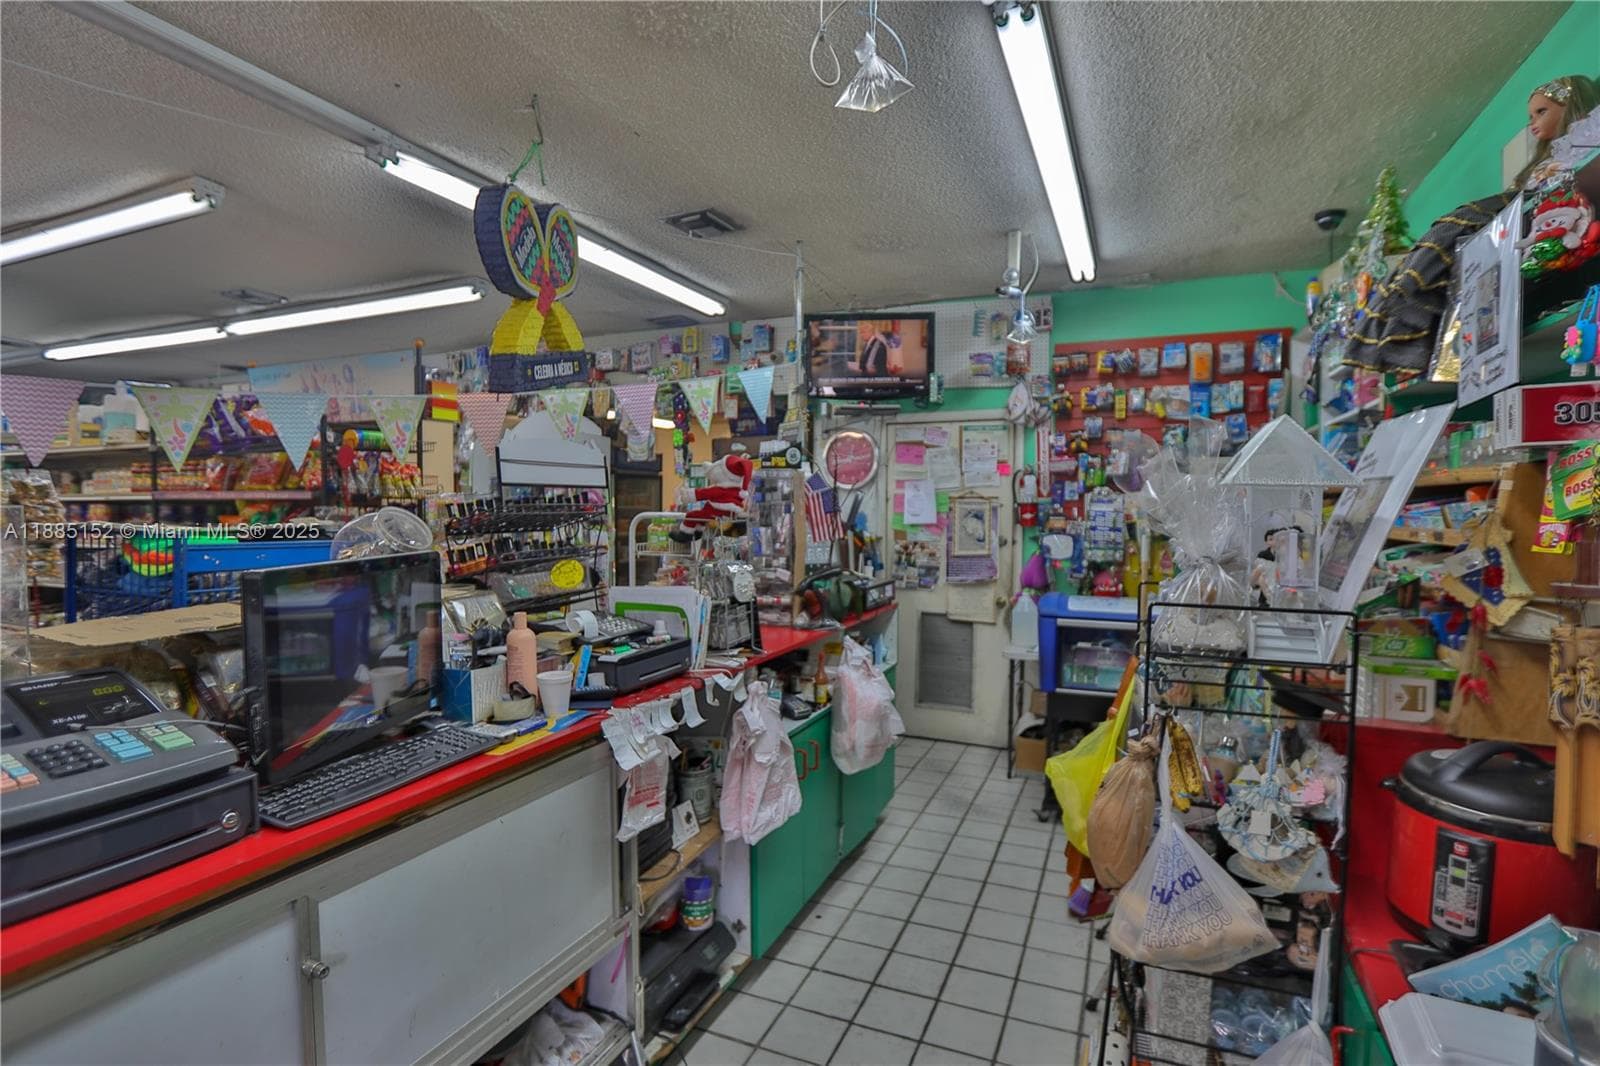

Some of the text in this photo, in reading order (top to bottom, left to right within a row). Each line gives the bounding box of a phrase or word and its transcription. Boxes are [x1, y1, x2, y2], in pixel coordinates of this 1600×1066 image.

[1559, 446, 1593, 469] BOSS
[1565, 477, 1594, 497] BOSS
[1188, 894, 1225, 918] YOU
[1200, 909, 1233, 937] YOU
